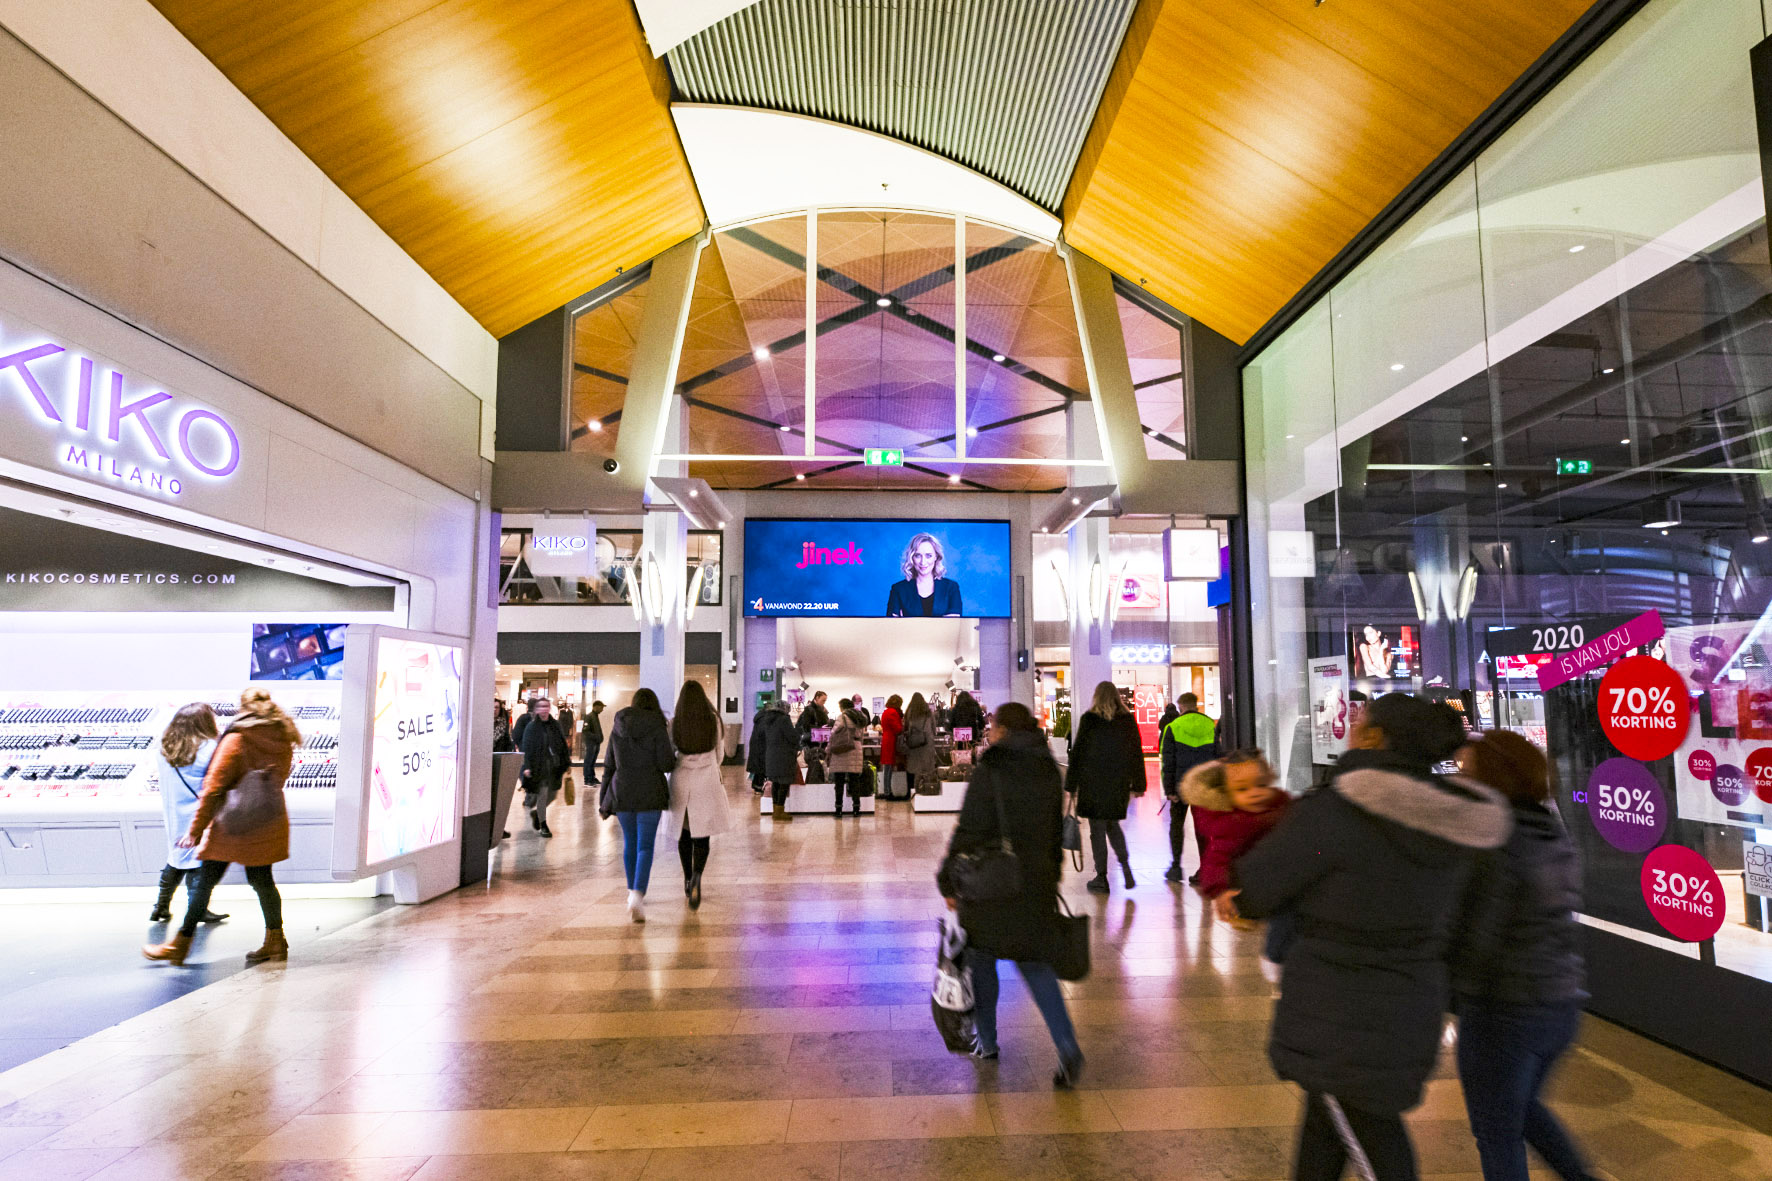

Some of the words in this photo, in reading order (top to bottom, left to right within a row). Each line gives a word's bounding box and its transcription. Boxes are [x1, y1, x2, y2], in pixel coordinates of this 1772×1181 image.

[0, 342, 240, 477] KIKO
[66, 446, 183, 495] MILANO
[533, 536, 586, 549] KIKO
[796, 542, 863, 568] jinek
[6, 572, 237, 585] KIKOCOSMETICS.COM
[1532, 625, 1584, 652] 2020
[1561, 658, 1574, 675] IS
[1572, 643, 1601, 668] VAN
[1603, 628, 1631, 655] JOU
[1609, 687, 1675, 714] 70%
[398, 714, 433, 740] SALE
[1611, 716, 1677, 730] KORTING
[401, 750, 432, 775] 50%
[1693, 759, 1711, 767] 30%
[1717, 777, 1742, 789] 50%
[1717, 787, 1743, 795] KORTING
[1598, 785, 1655, 814] 50%
[1599, 808, 1655, 826] KORTING
[1652, 869, 1713, 904] 30%
[1750, 875, 1770, 883] CLICK
[1653, 893, 1714, 918] KORTING
